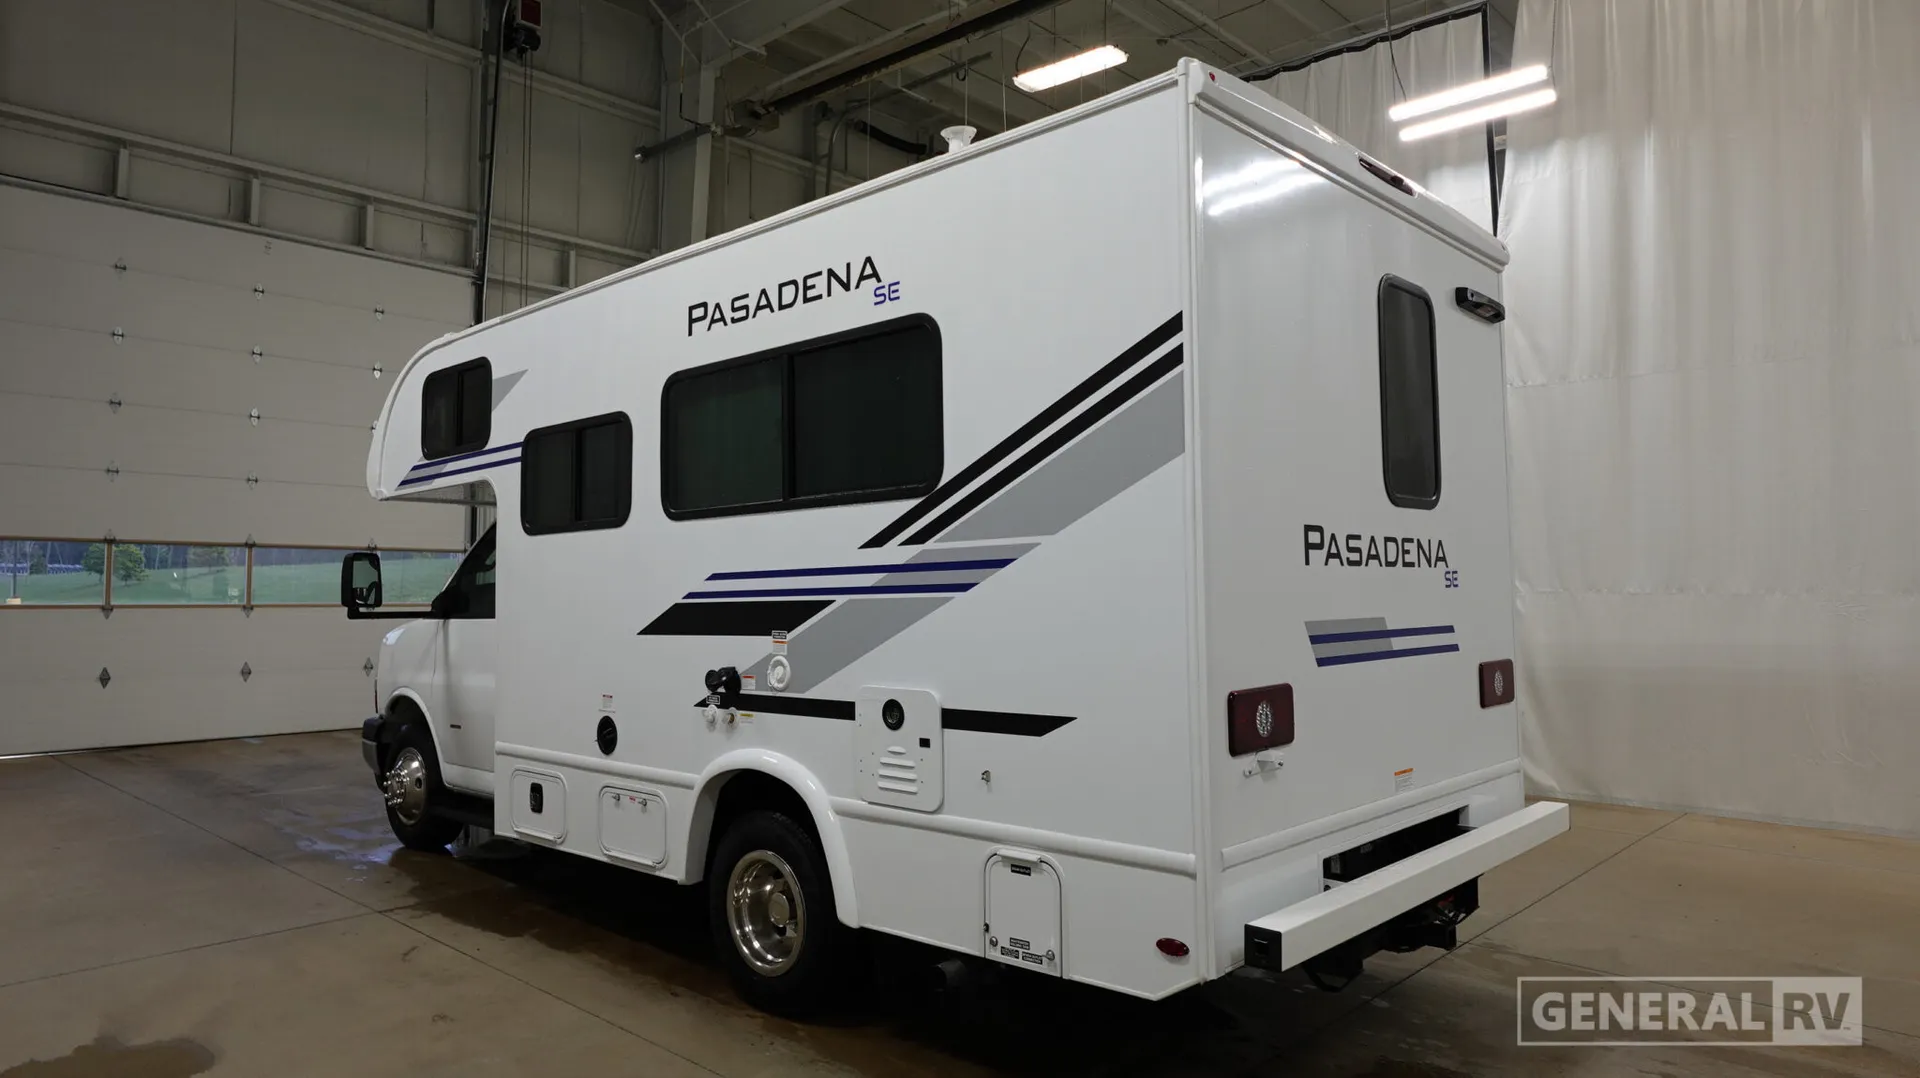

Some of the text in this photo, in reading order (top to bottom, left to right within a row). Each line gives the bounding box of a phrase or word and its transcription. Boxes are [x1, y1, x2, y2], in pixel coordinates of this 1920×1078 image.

[688, 256, 882, 337] PASADENA
[873, 281, 900, 306] SE
[1303, 524, 1449, 569] PASADENA
[1444, 570, 1459, 588] SE
